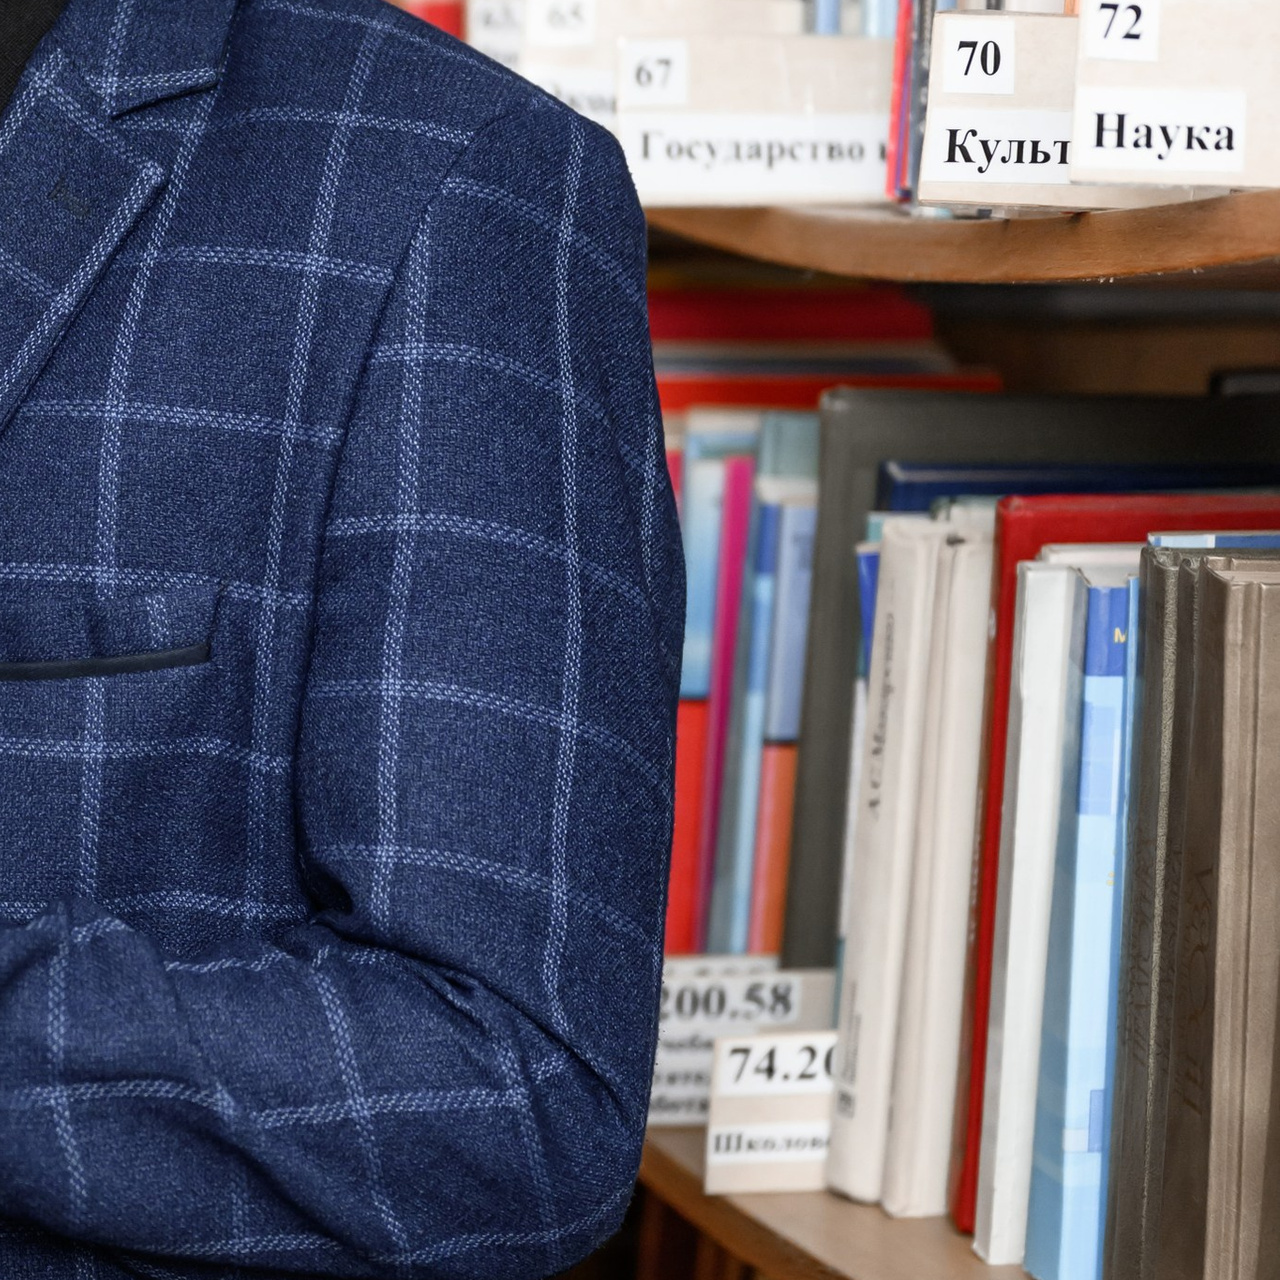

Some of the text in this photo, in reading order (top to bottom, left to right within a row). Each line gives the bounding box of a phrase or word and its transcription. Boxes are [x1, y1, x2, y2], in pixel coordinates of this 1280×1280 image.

[1099, 3, 1143, 40] 72
[634, 57, 672, 88] 67
[957, 40, 1001, 76] 70
[640, 131, 865, 170] Государство
[943, 128, 1070, 174] Культ
[1094, 112, 1235, 161] Наука
